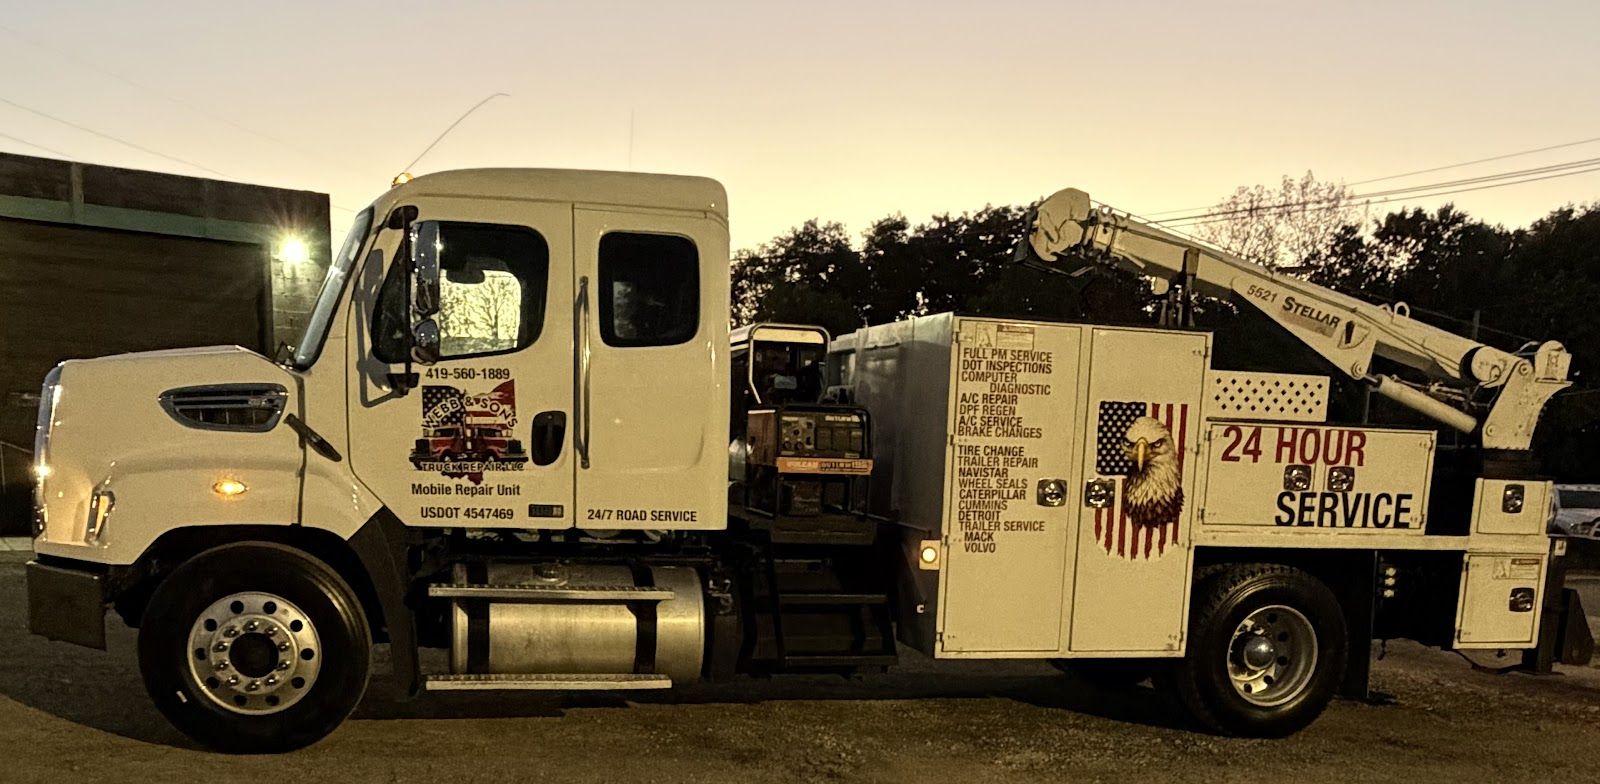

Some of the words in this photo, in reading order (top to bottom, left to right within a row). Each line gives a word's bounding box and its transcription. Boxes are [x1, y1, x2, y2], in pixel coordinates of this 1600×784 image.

[1247, 284, 1278, 303] 5521
[1282, 296, 1341, 328] STELLAR
[963, 347, 987, 359] FULL
[991, 348, 1007, 359] PM
[1010, 350, 1053, 362] SERVICE
[962, 360, 985, 370] DOT
[986, 361, 1052, 374] INSPECTIONS
[425, 368, 510, 379] 419-560-1889
[961, 371, 1017, 382] COMPUTER
[990, 383, 1051, 395] DIAGNOSTIC
[960, 393, 979, 403] A/C
[982, 394, 1018, 405] REPAIR
[421, 398, 460, 430] WEBB
[464, 396, 474, 407] &
[480, 398, 518, 428] SONS
[960, 404, 979, 415] DPF
[982, 405, 1016, 416] REGEN
[959, 415, 977, 426] A/C
[980, 416, 1023, 427] SERVICE
[958, 426, 992, 437] BRAKE
[995, 427, 1042, 438] CHANGES
[958, 445, 980, 456] TIRE
[983, 445, 1024, 456] CHANGE
[1221, 425, 1263, 463] 24
[1275, 427, 1367, 466] HOUR
[422, 463, 460, 471] TRUCK
[463, 463, 504, 471] REPAIR
[506, 463, 524, 471] LLC
[957, 456, 1000, 467] TRAILER
[1003, 457, 1038, 468] REPAIR
[958, 468, 1008, 478] NAVISTAR
[958, 478, 992, 488] WHEEL
[996, 479, 1028, 489] SEALS
[411, 484, 451, 495] Mobile
[456, 484, 494, 497] Repair
[497, 484, 520, 495] Unit
[959, 489, 1026, 499] CATERPILLAR
[958, 500, 1008, 510] CUMMINS
[1275, 491, 1413, 529] SERVICE
[420, 506, 461, 519] USDOT
[463, 508, 514, 520] 4547469
[587, 509, 613, 520] 24/7
[616, 510, 647, 521] ROAD
[650, 510, 697, 522] SERVICE
[958, 510, 1001, 520] DETROIT
[959, 521, 1001, 531] TRAILER
[1003, 521, 1045, 531] SERVICE
[964, 532, 994, 541] MACK
[964, 543, 996, 553] VOLVO
